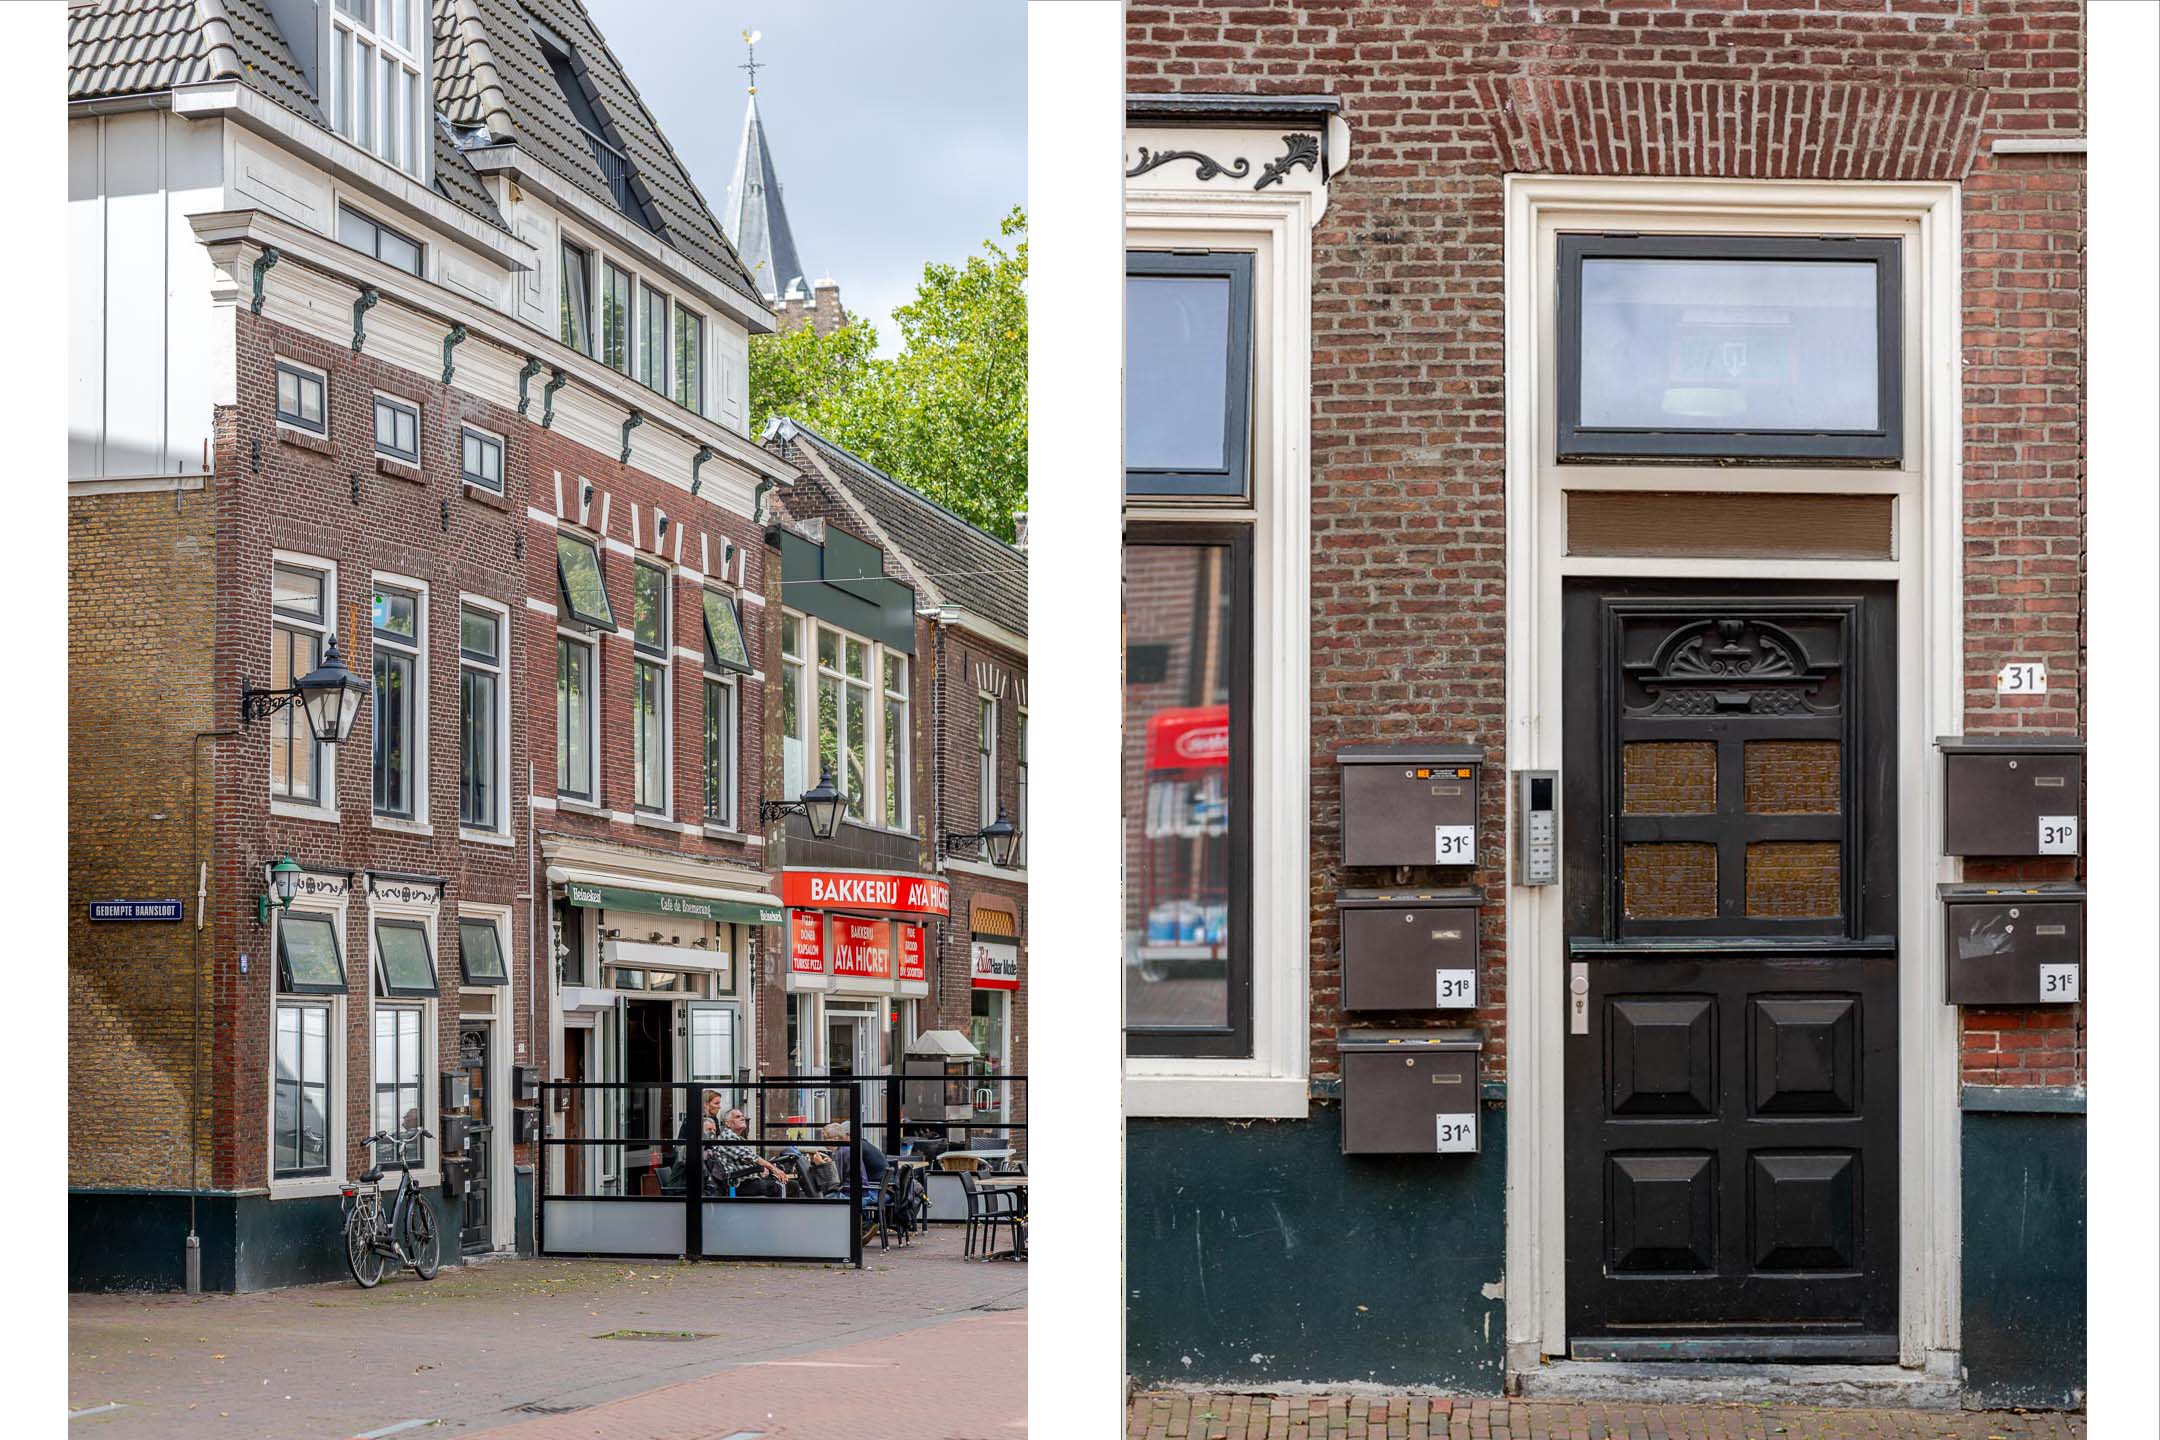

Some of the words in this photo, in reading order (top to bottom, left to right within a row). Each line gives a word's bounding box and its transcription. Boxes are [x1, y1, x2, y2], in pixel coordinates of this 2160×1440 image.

[2009, 666, 2034, 690] 31
[572, 887, 602, 903] Heineken
[811, 878, 897, 905] BAKKERIJ
[907, 882, 929, 907] AYA
[96, 905, 133, 917] GEDEMPTE
[135, 905, 176, 917] BAANSLOOT
[673, 898, 681, 912] de
[682, 899, 712, 919] Boemerang
[850, 924, 874, 941] BAKKERIJ
[834, 943, 854, 970] AYA
